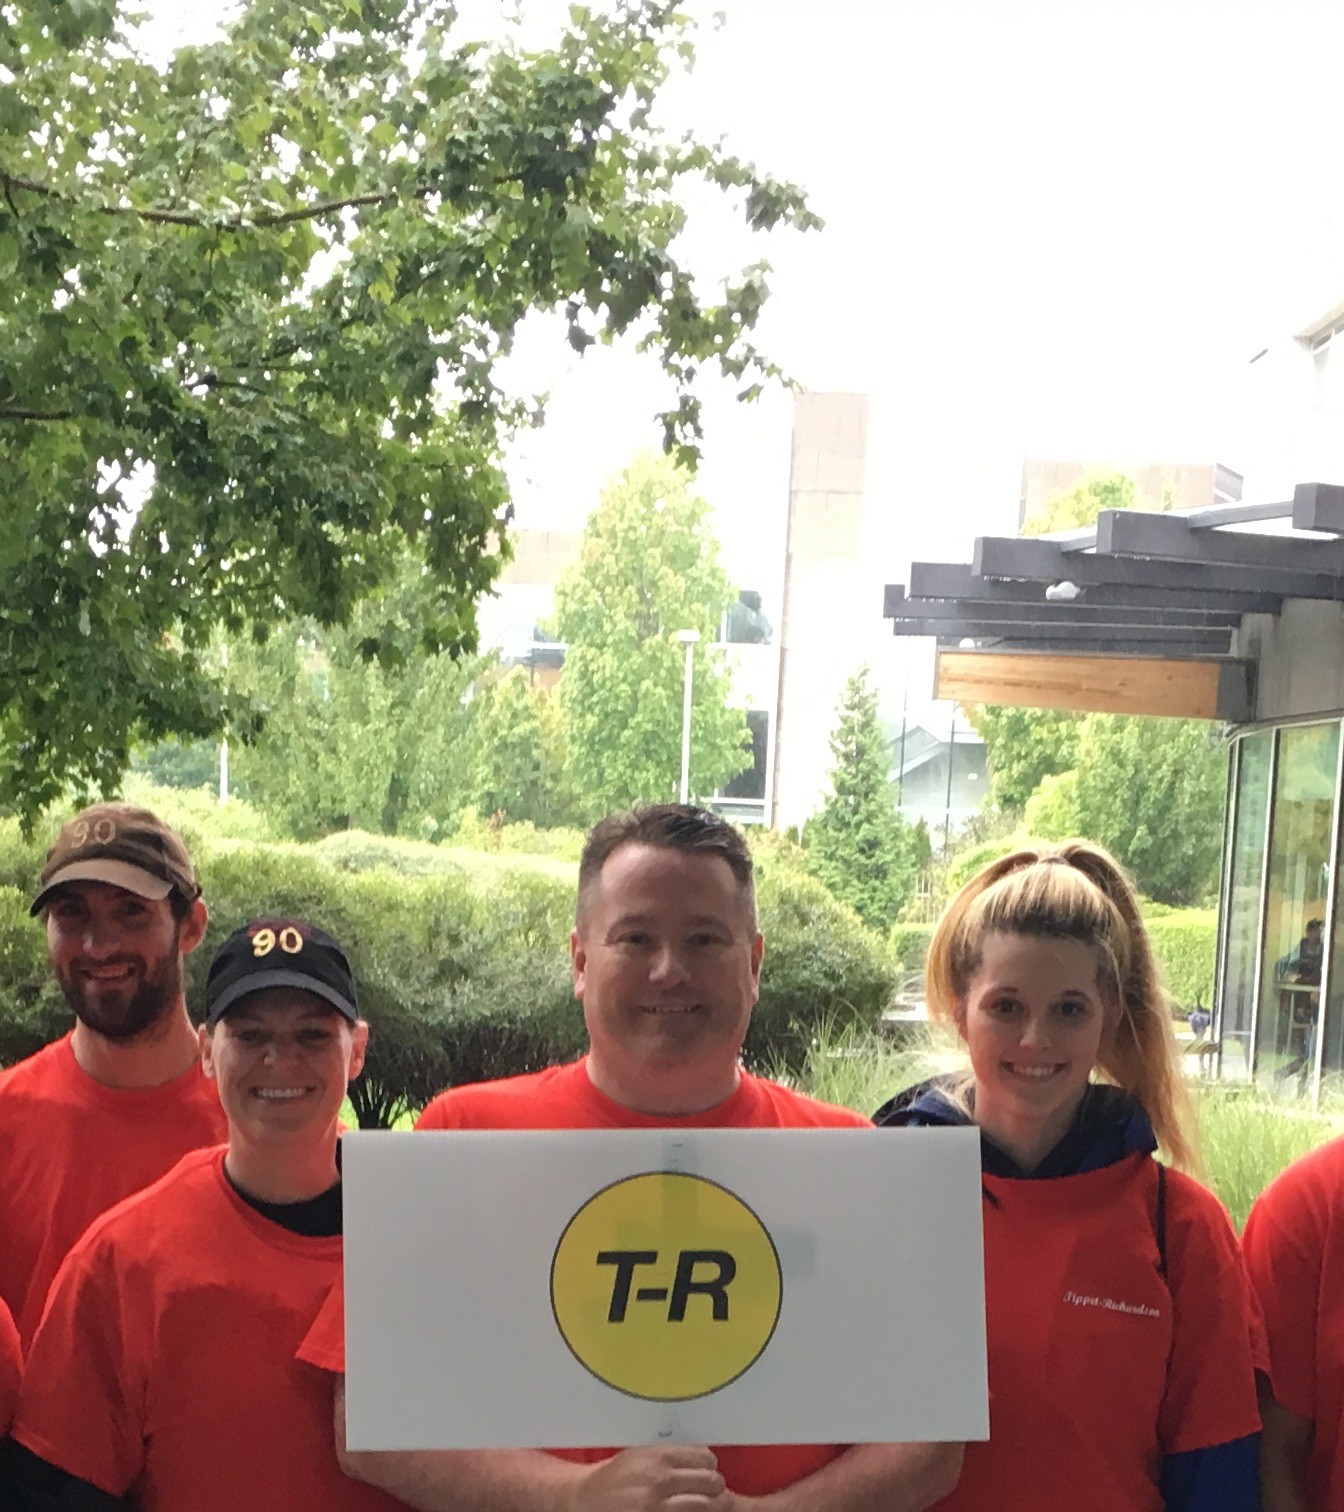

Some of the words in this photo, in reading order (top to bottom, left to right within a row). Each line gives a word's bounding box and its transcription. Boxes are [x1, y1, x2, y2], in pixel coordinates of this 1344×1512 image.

[71, 819, 116, 849] 90
[252, 926, 303, 957] 90
[596, 1250, 737, 1323] T-R
